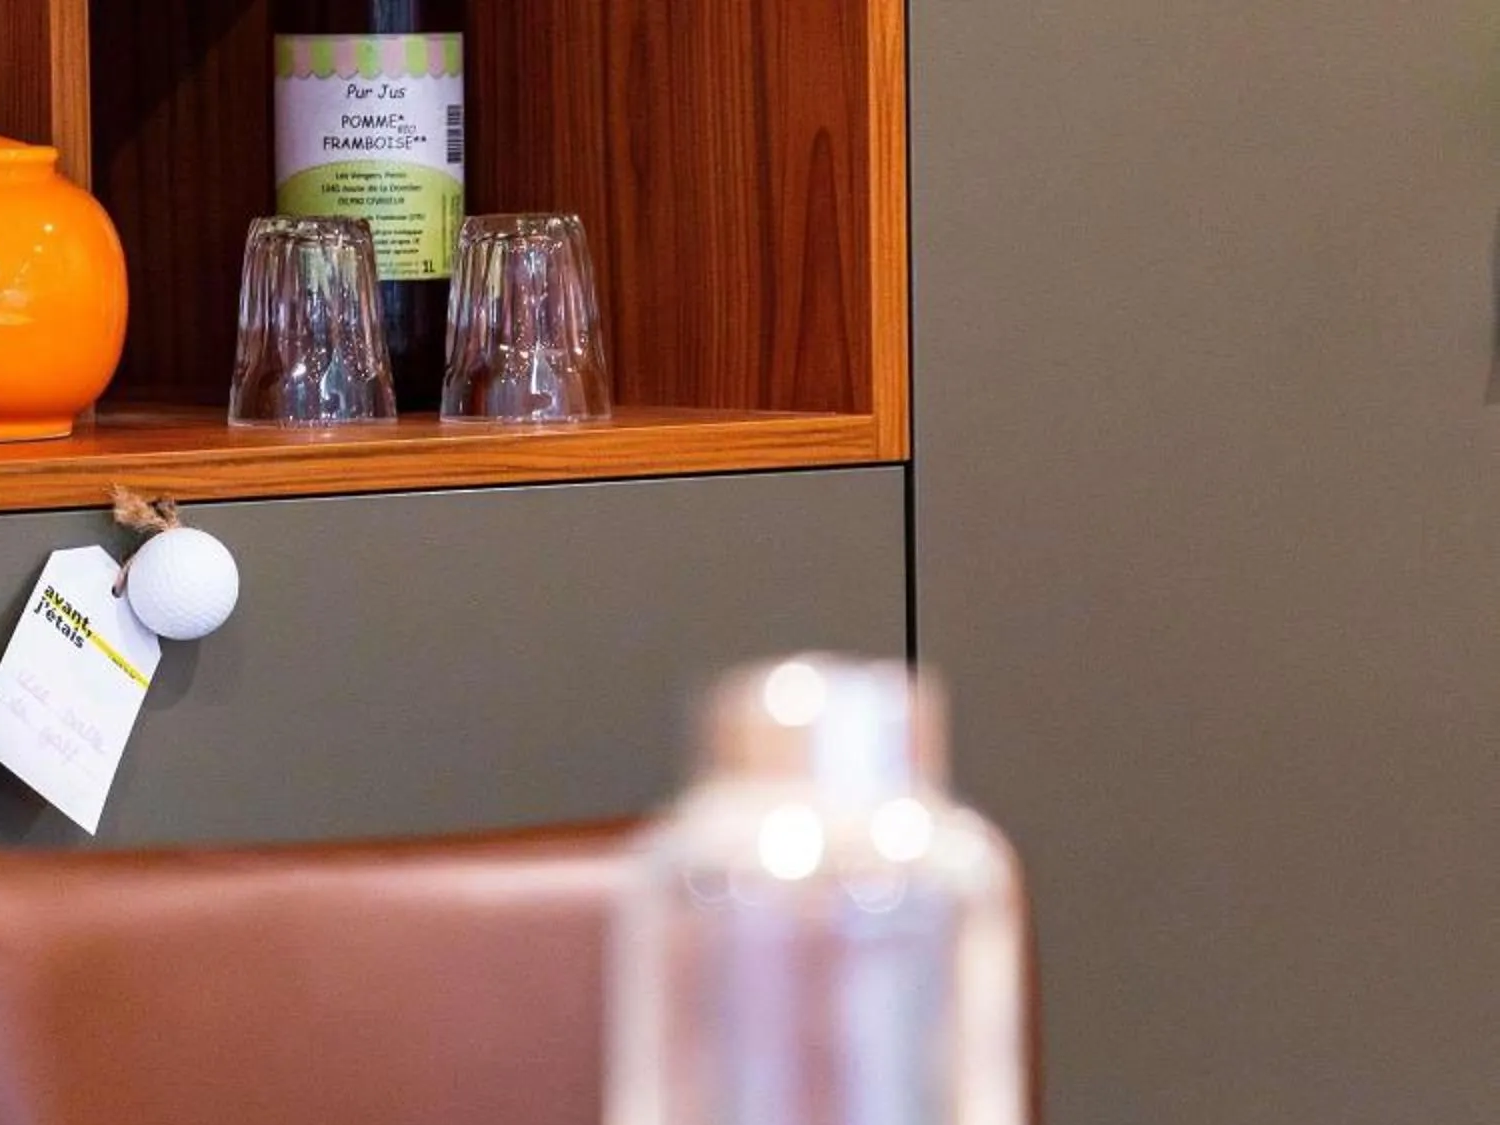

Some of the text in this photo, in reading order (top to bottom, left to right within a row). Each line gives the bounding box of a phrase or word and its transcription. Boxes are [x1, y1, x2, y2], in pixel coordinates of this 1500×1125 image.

[346, 83, 406, 99] Pur Jus
[43, 585, 92, 638] avant,
